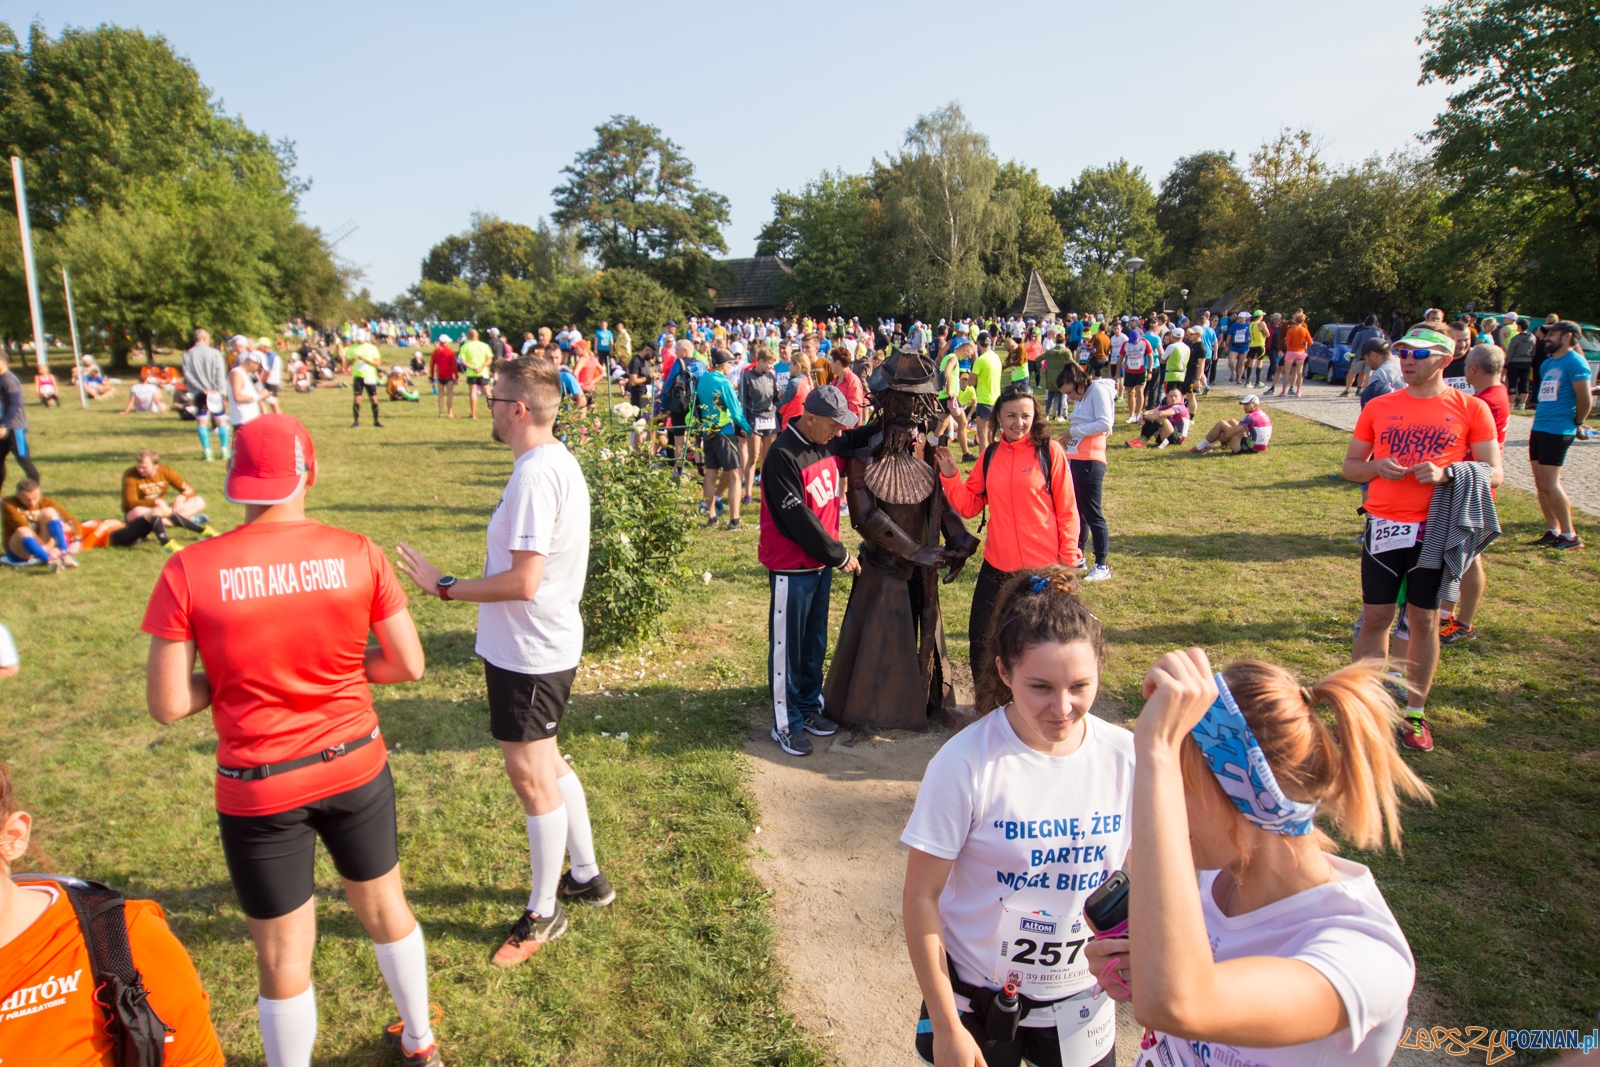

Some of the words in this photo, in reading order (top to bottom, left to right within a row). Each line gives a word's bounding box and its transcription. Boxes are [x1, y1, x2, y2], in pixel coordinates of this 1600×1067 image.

[1380, 429, 1458, 447] FINISHER
[806, 467, 840, 508] US
[1375, 525, 1411, 541] 2523
[219, 566, 265, 602] PIOTR
[268, 562, 300, 596] AKA
[299, 557, 347, 592] GRUBY
[1091, 811, 1123, 835] ŻEB
[1031, 845, 1107, 867] BARTEK
[996, 870, 1050, 891] MÓGŁ
[1056, 869, 1109, 891] BIEGA
[1011, 935, 1096, 967] 257
[1026, 973, 1038, 981] 39
[1040, 973, 1061, 981] BIEG
[1063, 969, 1090, 980] LECHIT
[0, 968, 83, 1012] HITÓW
